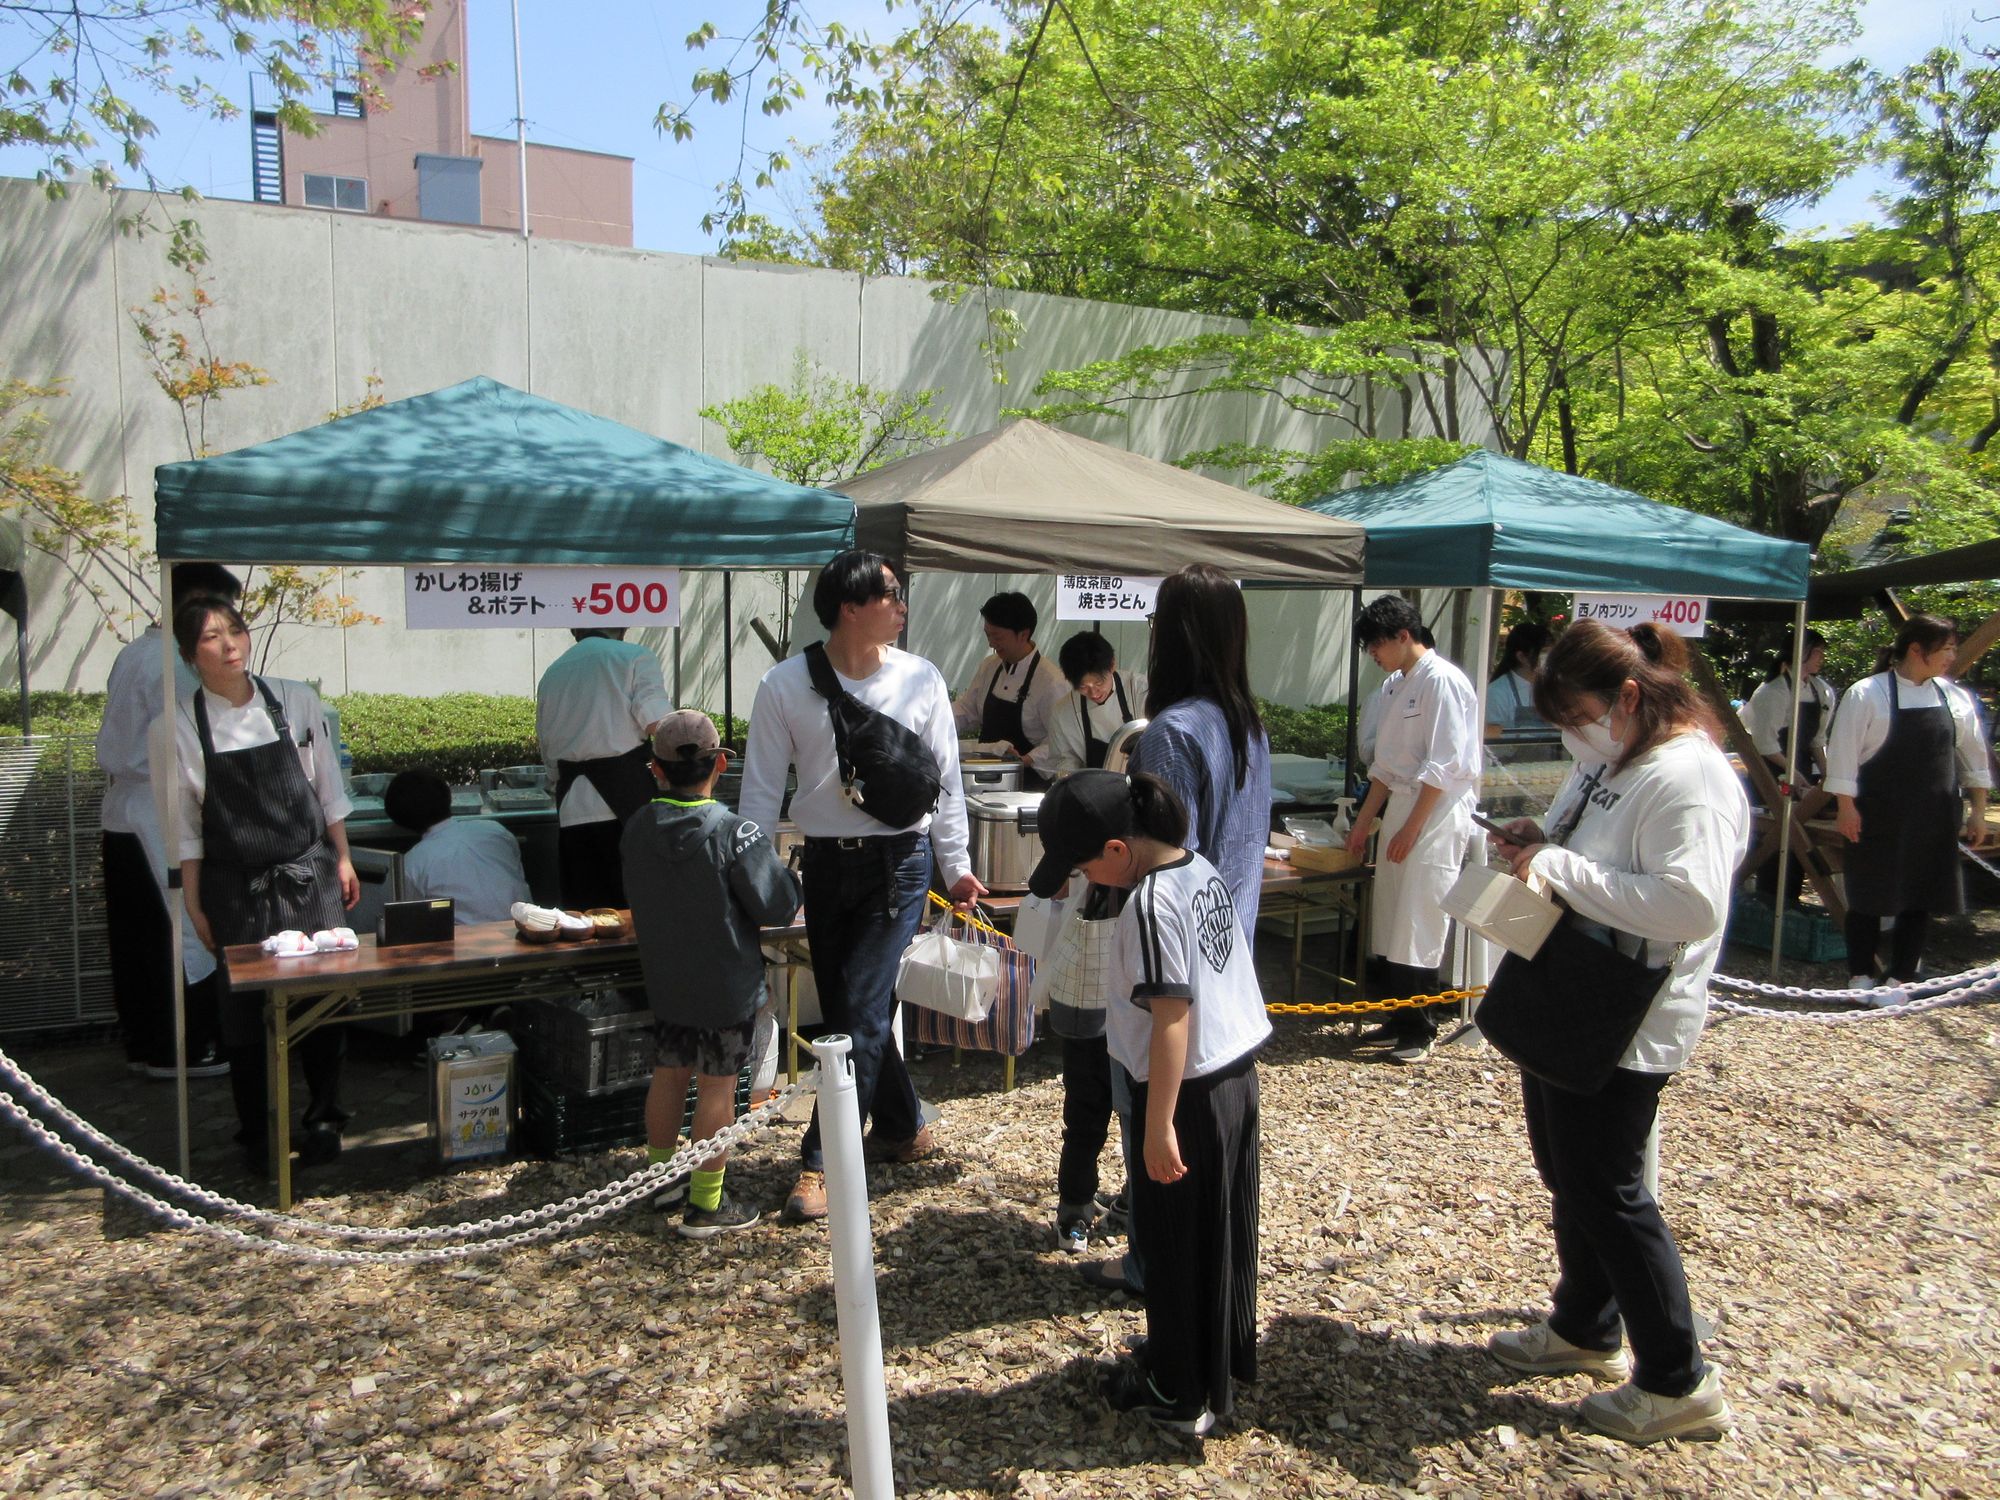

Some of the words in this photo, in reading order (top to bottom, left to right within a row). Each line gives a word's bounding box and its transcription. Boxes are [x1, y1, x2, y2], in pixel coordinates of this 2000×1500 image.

[415, 571, 523, 592] かしわ揚げ
[1063, 575, 1123, 590] 薄皮茶屋の
[572, 582, 668, 616] ¥500
[1078, 592, 1146, 610] 焼きうどん
[1577, 602, 1638, 619] 西ノ内プリン
[1651, 600, 1701, 624] ¥400
[458, 1106, 500, 1120] サラダ油
